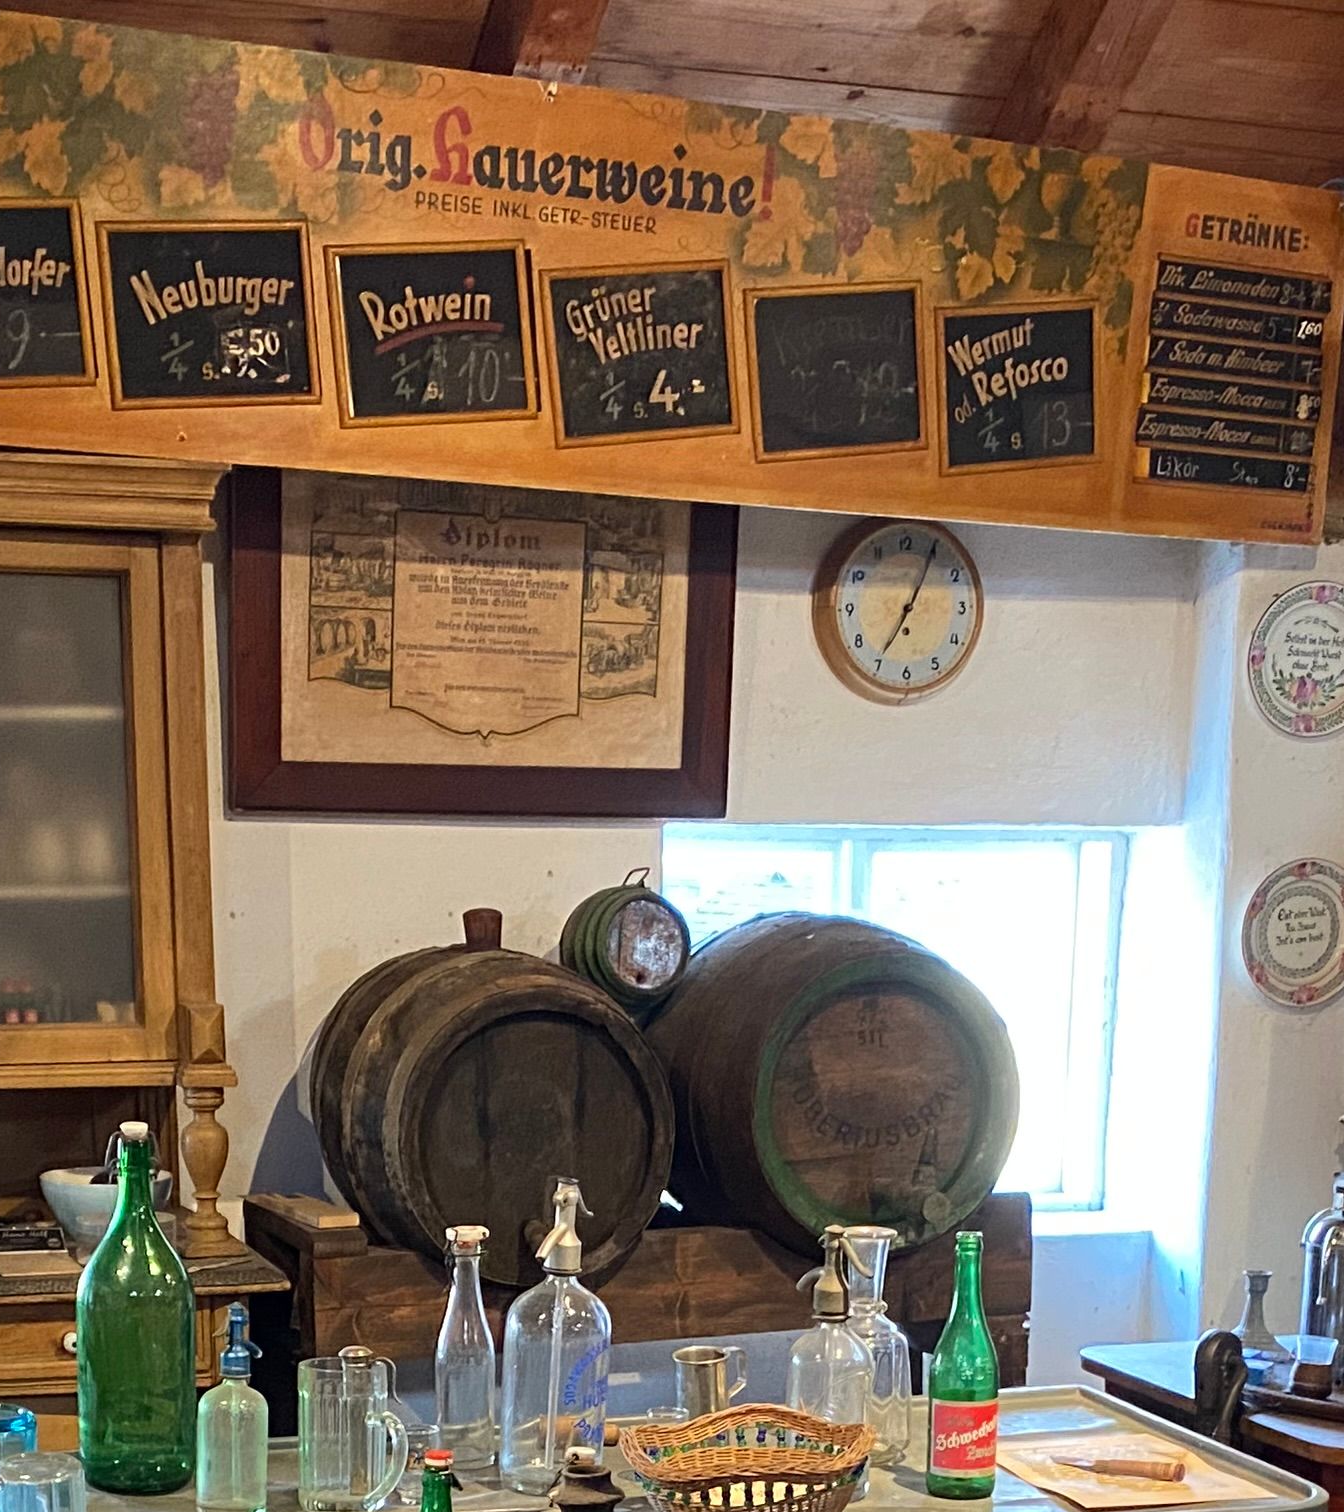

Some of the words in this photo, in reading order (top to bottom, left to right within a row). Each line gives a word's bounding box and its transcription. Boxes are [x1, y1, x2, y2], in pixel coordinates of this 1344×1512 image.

[298, 97, 427, 192] Orig.
[415, 191, 483, 215] PREISE
[1185, 213, 1310, 252] GETRÄNKE:
[130, 260, 294, 325] Neuburger
[1190, 270, 1280, 299] Limonaden
[359, 275, 492, 341] Rotwein
[566, 286, 656, 342] Grüner
[588, 314, 704, 364] Veltliner
[947, 318, 1034, 376] Wermut
[1169, 341, 1206, 365] Soda
[972, 357, 1069, 407] Refosco
[441, 516, 541, 551] Diplom
[899, 536, 912, 550] 12
[852, 571, 864, 583] 10
[950, 568, 959, 582] 2
[845, 603, 854, 616] 9
[958, 602, 966, 615] 3
[854, 634, 863, 648] 8
[950, 633, 958, 645] 4
[874, 659, 882, 671] 7
[902, 666, 911, 680] 6
[931, 658, 939, 670] 5
